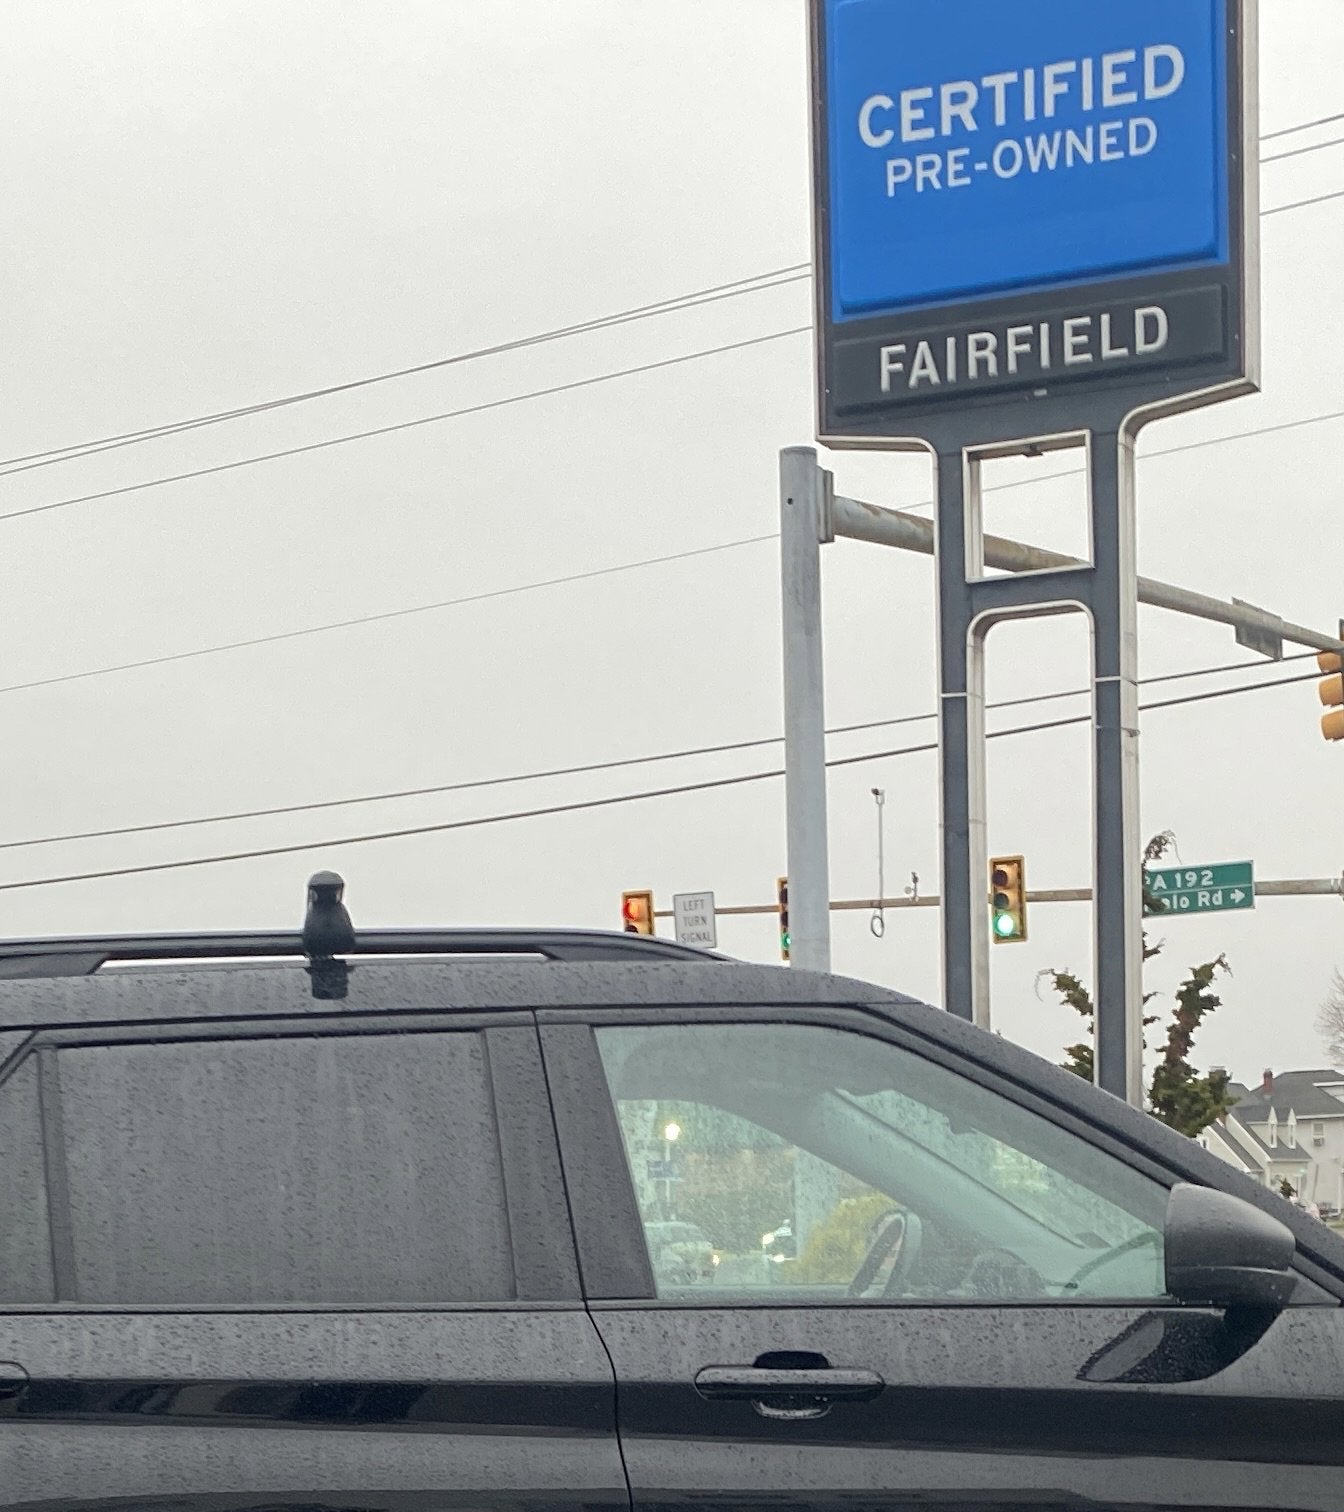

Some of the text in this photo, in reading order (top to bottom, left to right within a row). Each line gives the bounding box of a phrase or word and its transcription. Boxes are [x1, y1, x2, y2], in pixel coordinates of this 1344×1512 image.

[858, 44, 1186, 149] CERTIFIED
[886, 116, 1158, 197] PRE-OWNED
[879, 306, 1170, 393] FAIRFIELD
[1174, 869, 1214, 889] 192
[682, 899, 705, 911] LEFT
[1197, 889, 1223, 907] Rd
[683, 915, 708, 927] TURN
[680, 931, 713, 943] SIGNAL
